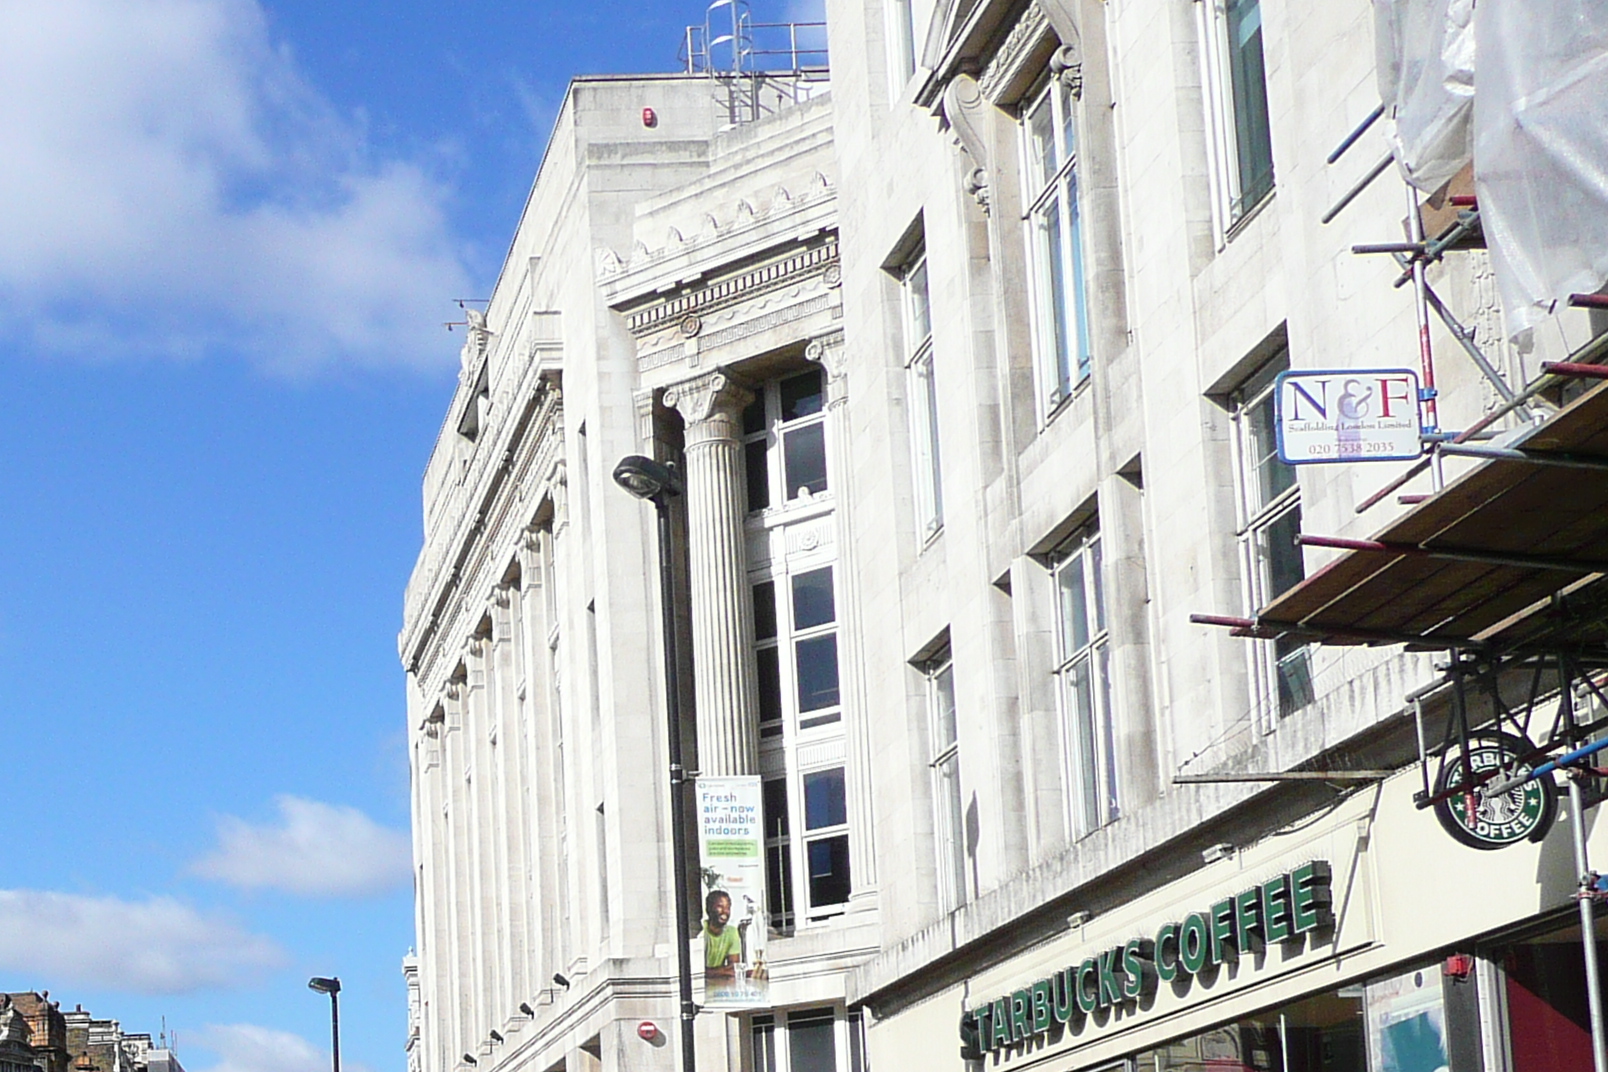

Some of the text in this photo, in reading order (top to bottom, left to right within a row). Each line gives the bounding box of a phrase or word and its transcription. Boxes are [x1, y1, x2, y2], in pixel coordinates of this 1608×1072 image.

[1286, 376, 1409, 421] N & F
[1288, 419, 1411, 433] Scaffolding London Limited
[1309, 442, 1394, 454] 020 7538 2035
[702, 792, 737, 802] Fresh
[703, 804, 719, 813] air
[730, 805, 755, 813] now
[704, 814, 756, 824] available
[1465, 812, 1533, 838] OFFEE
[704, 825, 750, 835] indoors
[1154, 864, 1319, 982] COFFEE
